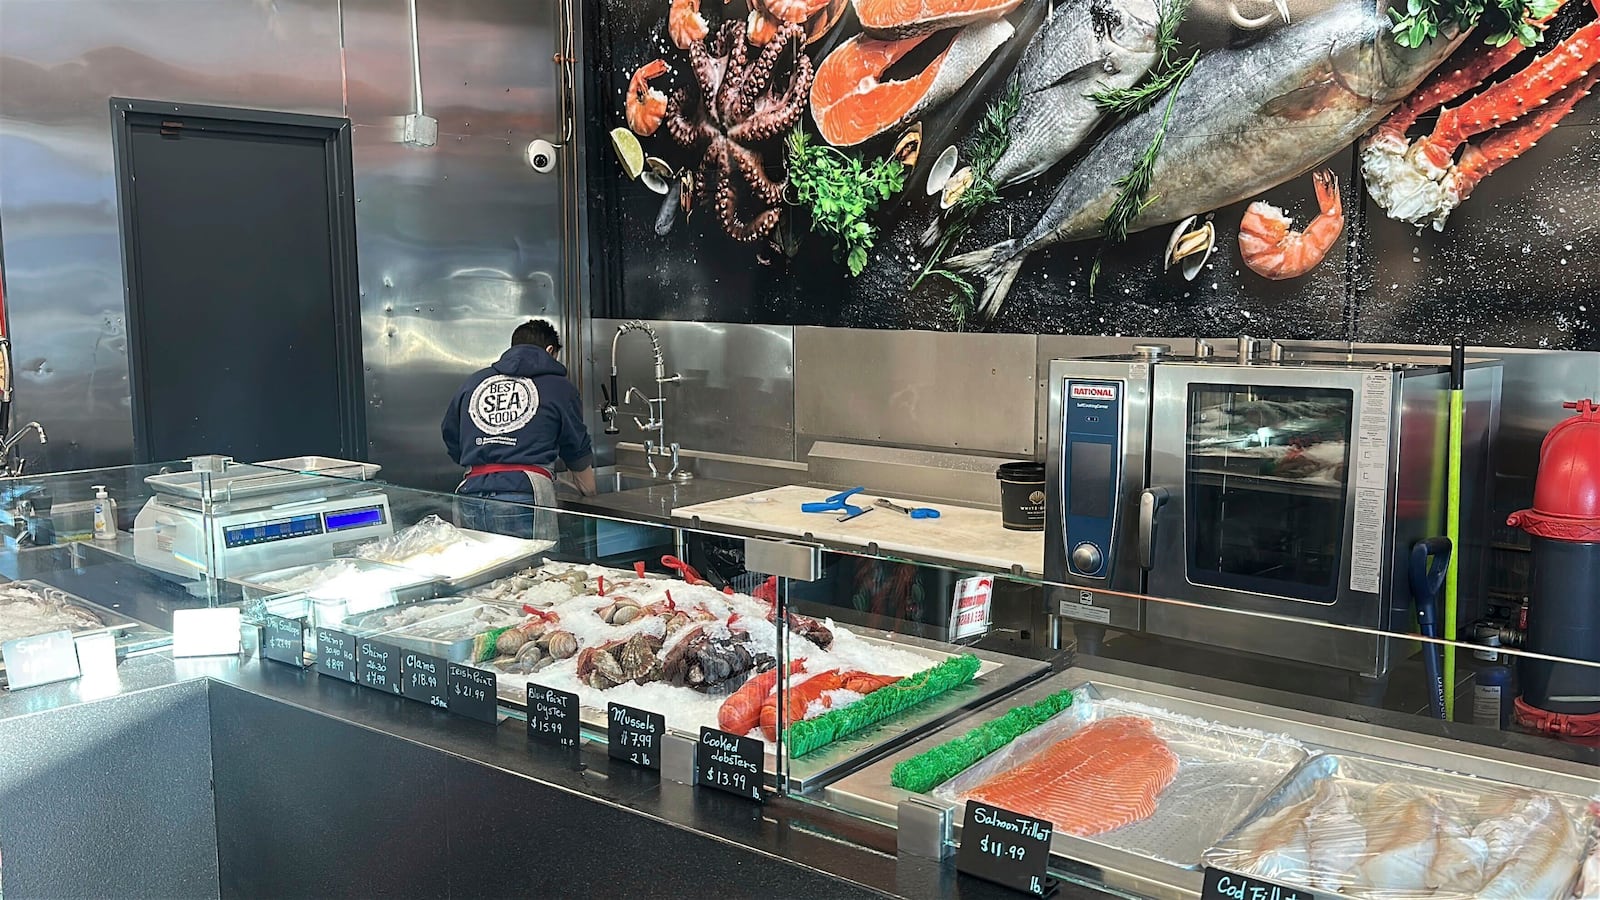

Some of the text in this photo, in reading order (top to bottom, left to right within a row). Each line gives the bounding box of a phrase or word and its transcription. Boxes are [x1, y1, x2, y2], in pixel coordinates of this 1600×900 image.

[490, 382, 516, 393] BEST
[1073, 387, 1113, 397] RATIONAL
[483, 392, 521, 413] SEA
[488, 411, 518, 424] FOOD
[406, 654, 436, 673] Clams
[412, 673, 437, 687] $18.99
[536, 702, 567, 721] Oyster
[610, 706, 655, 733] Mussels
[702, 731, 740, 752] Cooked
[630, 753, 640, 765] 2
[706, 766, 746, 791] $13.99
[974, 807, 1051, 842] Salmon Fillet
[980, 834, 1026, 861] $11.99
[1216, 876, 1247, 900] Cod
